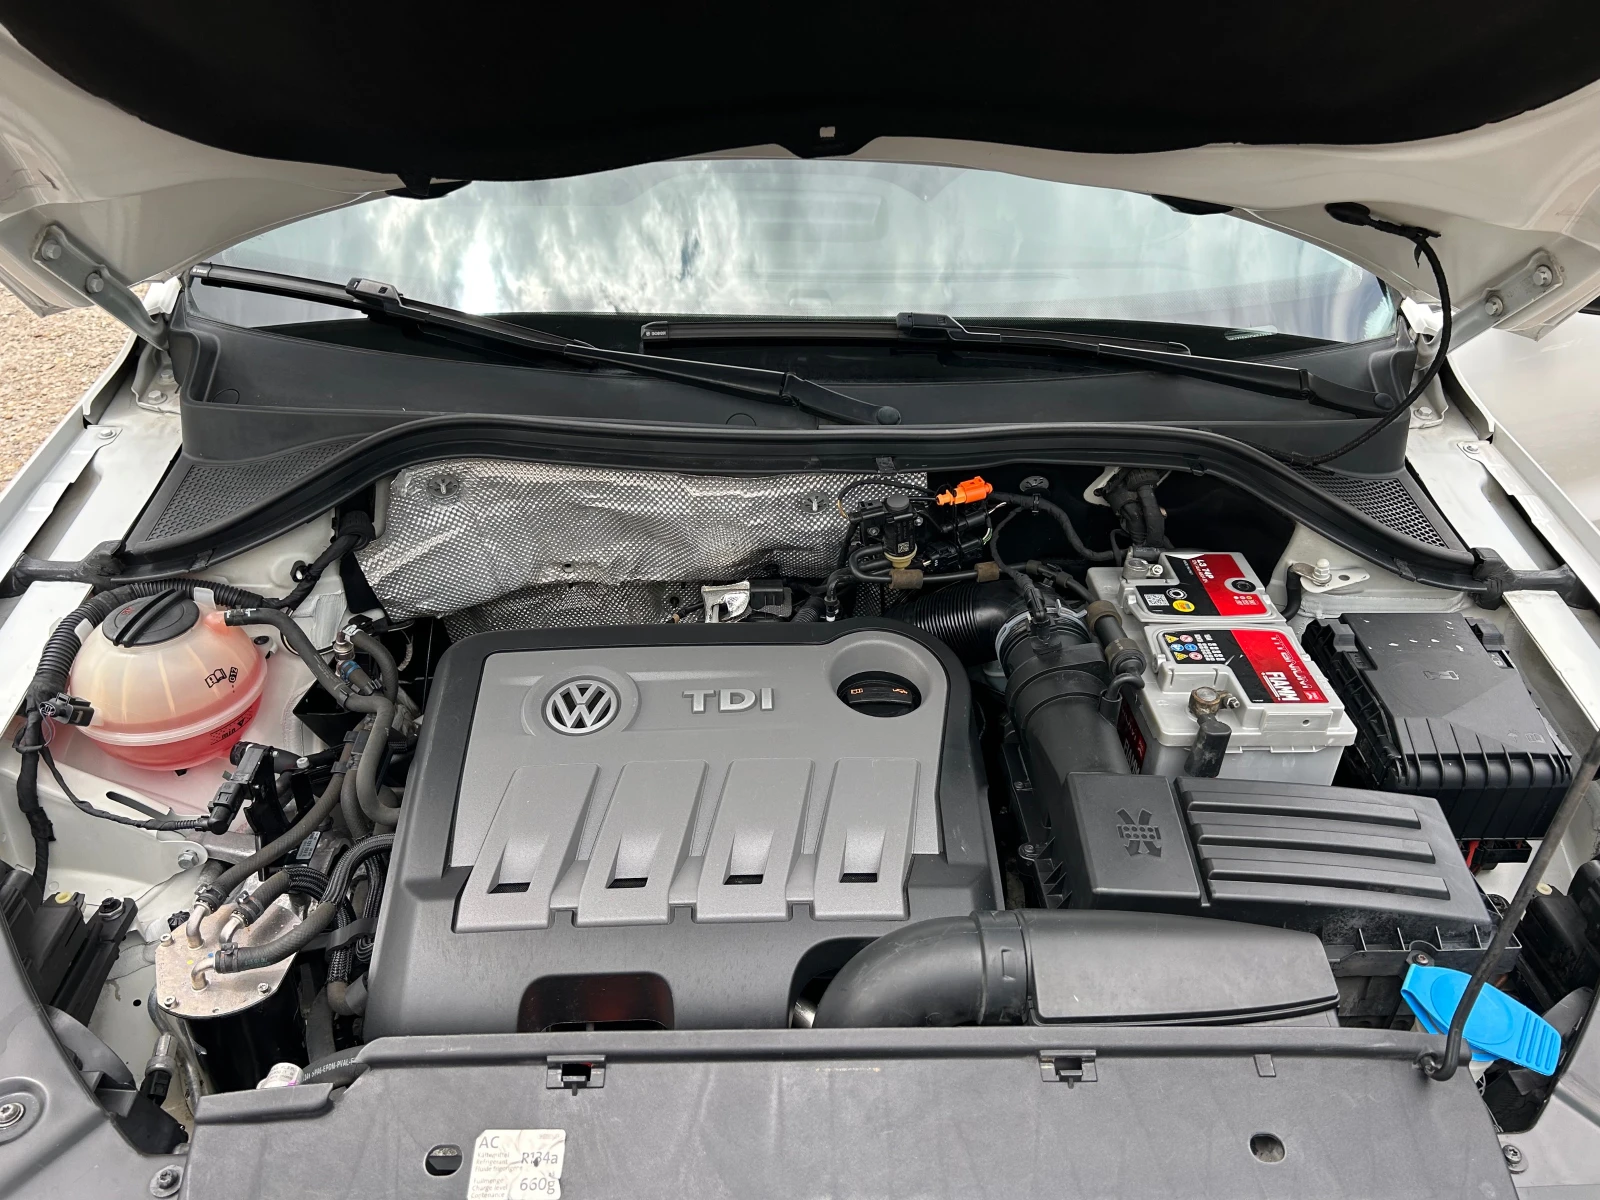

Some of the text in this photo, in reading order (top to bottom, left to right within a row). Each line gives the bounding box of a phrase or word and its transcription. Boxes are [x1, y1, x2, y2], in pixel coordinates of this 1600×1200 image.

[1271, 634, 1312, 689] TITANIUM
[1265, 672, 1300, 701] FIAMM
[546, 680, 618, 733] VW
[682, 687, 774, 714] TDI
[221, 727, 236, 740] min
[478, 1136, 500, 1149] AC
[521, 1151, 559, 1165] R134a
[519, 1178, 556, 1195] 660g
